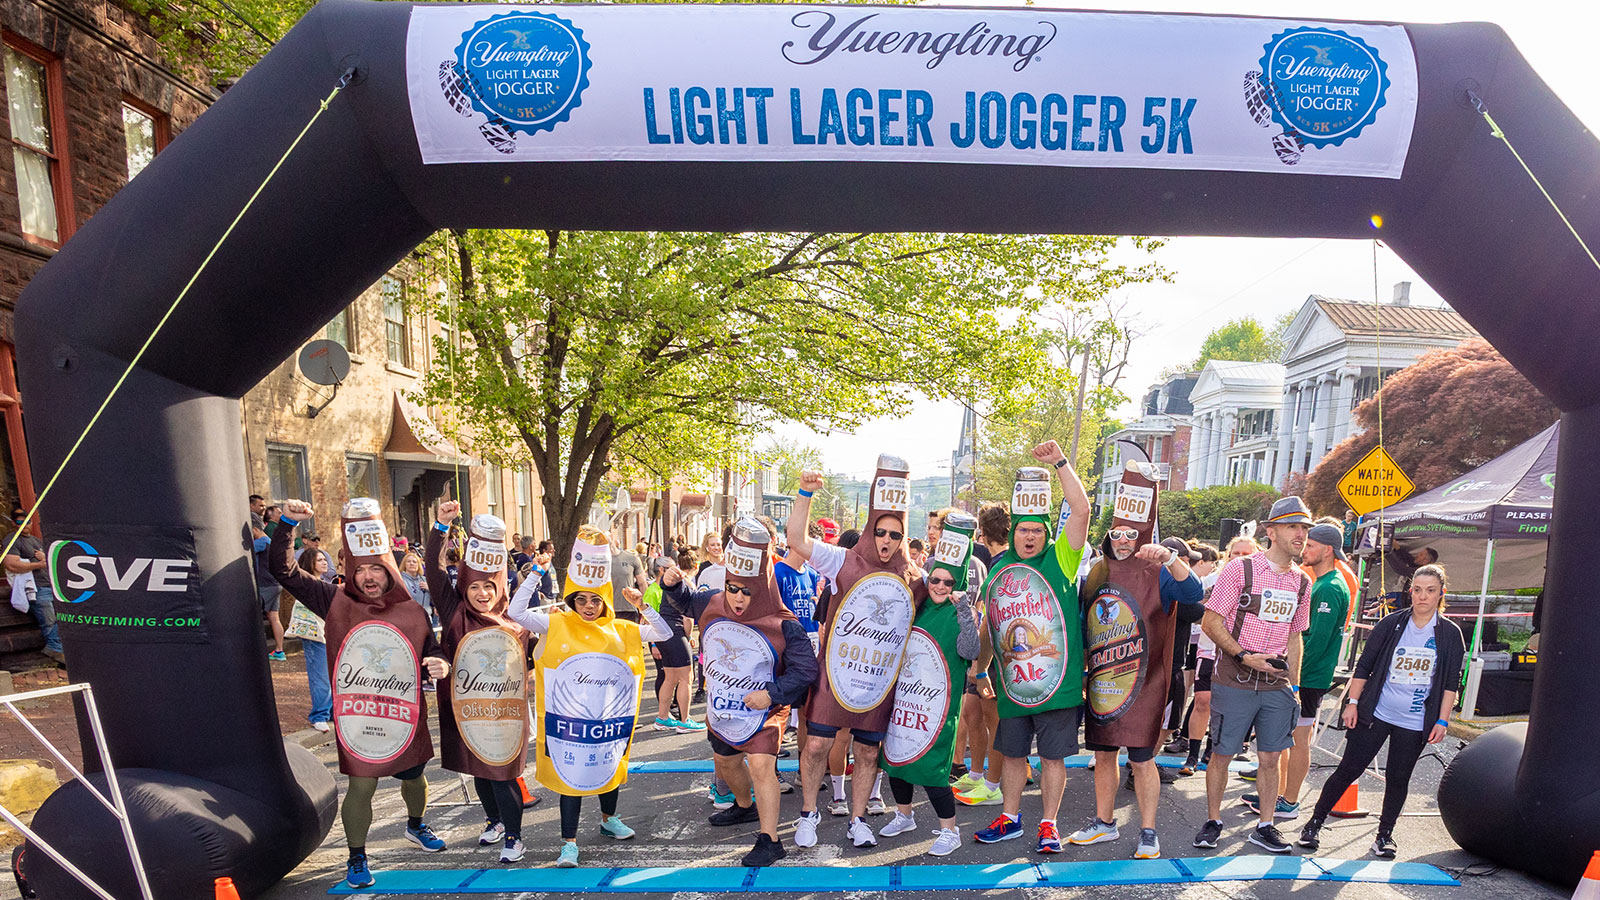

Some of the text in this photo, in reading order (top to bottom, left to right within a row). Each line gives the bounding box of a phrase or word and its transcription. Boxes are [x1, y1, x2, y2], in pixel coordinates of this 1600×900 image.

[781, 10, 1058, 73] Yuengling
[471, 41, 575, 68] Yuengling
[486, 69, 560, 80] LIGHT LAGER
[1275, 54, 1374, 85] Yuengling
[494, 81, 555, 100] JOGGER
[1290, 83, 1360, 96] LIGHT LAGER
[516, 107, 536, 118] 5K
[1295, 95, 1353, 112] JOGGER
[643, 86, 1198, 155] LIGHT LAGER JOGGER 5K
[1312, 121, 1330, 133] 5K
[1357, 468, 1394, 481] WATCH
[879, 489, 907, 504] 1472
[1016, 493, 1047, 507] 1046
[1347, 485, 1402, 497] CHILDREN
[1117, 496, 1146, 514] 1060
[1506, 511, 1547, 520] PLEASE
[1518, 524, 1548, 533] Find
[355, 532, 383, 548] 735
[470, 550, 504, 566] 1090
[937, 540, 961, 559] 1473
[727, 552, 754, 571] 1479
[66, 555, 193, 592] SVE
[576, 563, 605, 579] 1478
[996, 572, 1031, 598] Lord
[989, 590, 1055, 632] Chesterfield
[1263, 599, 1294, 616] 2567
[56, 612, 201, 627] WWW.SVETIMING.COM
[834, 611, 907, 650] Yuengling
[838, 642, 897, 669] GOLDEN
[1394, 656, 1431, 671] 2548
[847, 661, 885, 676] PILSNER
[1013, 661, 1048, 684] Ale
[1113, 662, 1138, 676] BEER
[337, 662, 416, 697] Yuengling
[455, 668, 523, 698] Yuengling
[1408, 687, 1428, 713] HAVE
[341, 700, 412, 721] PORTER
[461, 701, 521, 719] Oktoberfest
[556, 719, 625, 739] FLIGHT
